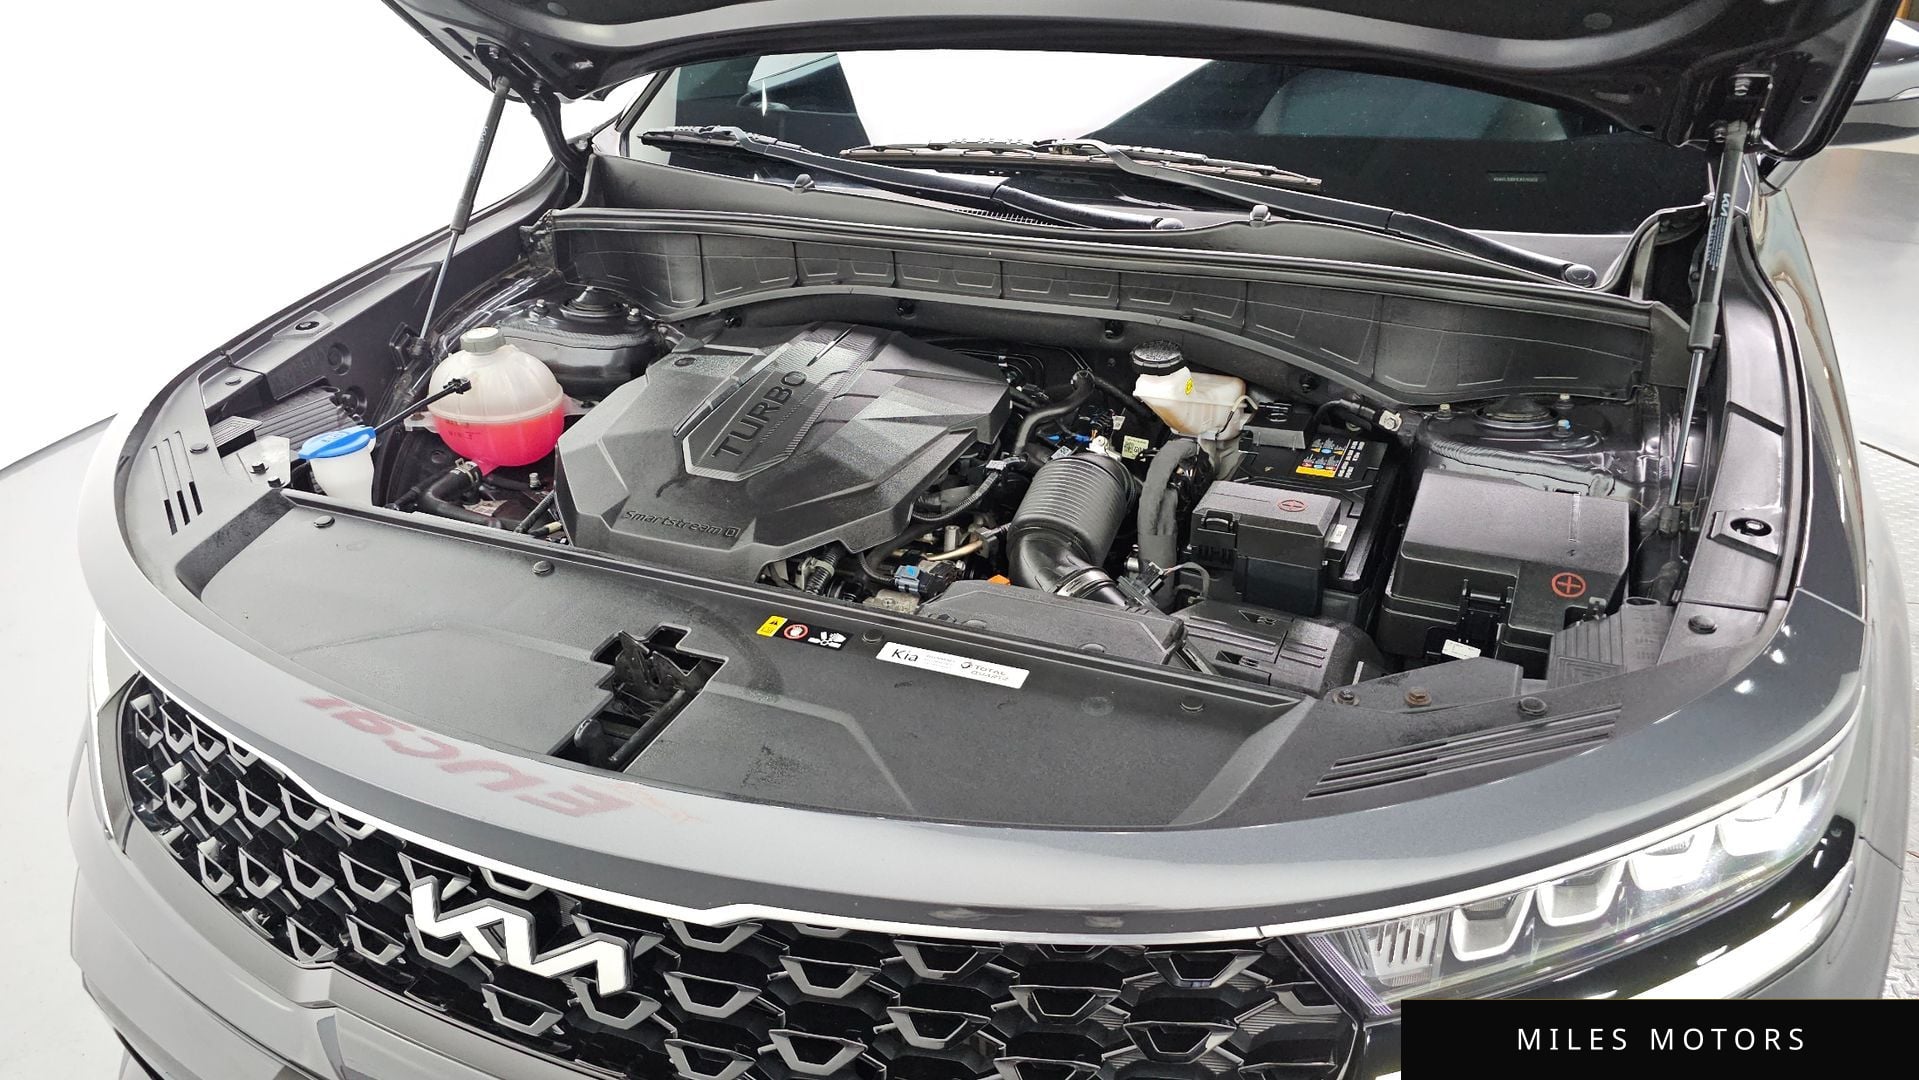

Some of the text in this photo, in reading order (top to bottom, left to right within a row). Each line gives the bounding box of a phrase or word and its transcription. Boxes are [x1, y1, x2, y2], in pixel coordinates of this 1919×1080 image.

[711, 371, 807, 457] TURBO
[625, 510, 723, 535] Smartstream
[891, 649, 919, 662] Kia
[970, 670, 1009, 681] QUARTZ
[974, 664, 1007, 676] TOTAL
[411, 875, 635, 998] KIA
